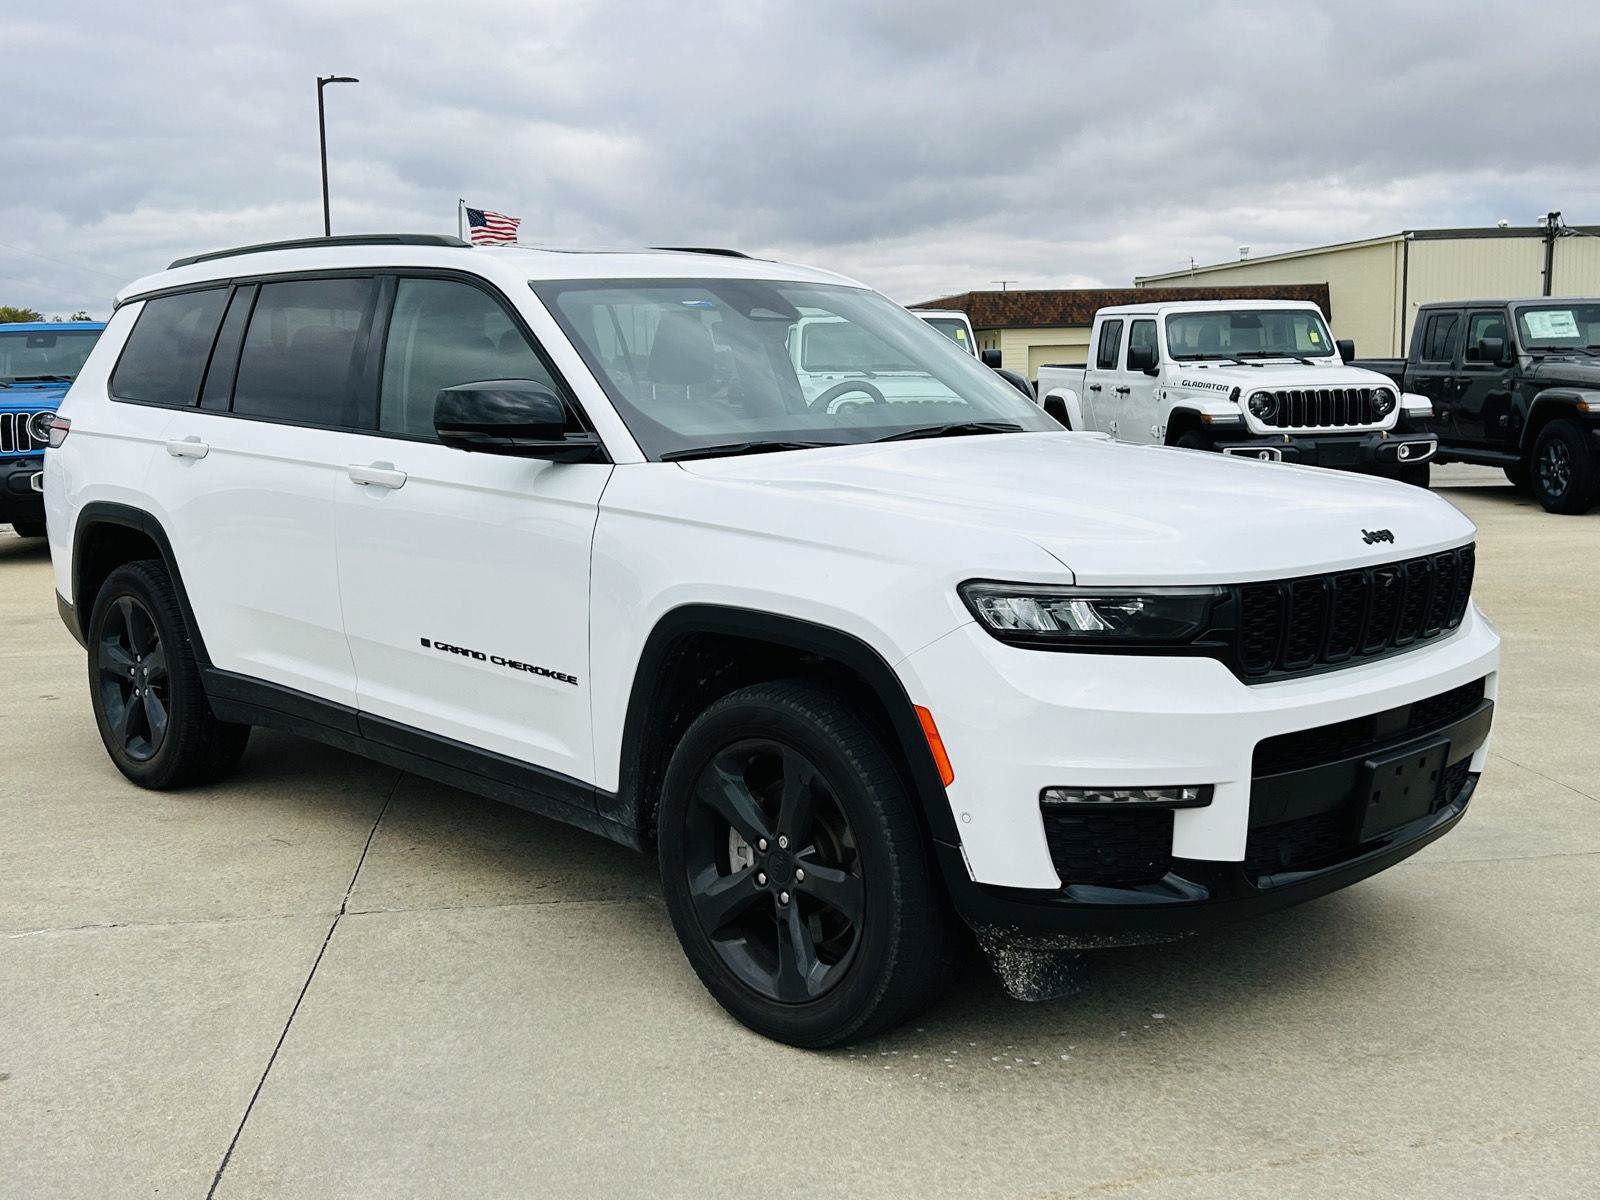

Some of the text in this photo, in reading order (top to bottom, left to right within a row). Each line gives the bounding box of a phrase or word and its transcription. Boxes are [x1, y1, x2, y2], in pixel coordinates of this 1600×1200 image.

[1182, 379, 1229, 392] GLADIATOR
[1361, 528, 1394, 545] Jeep
[434, 641, 578, 685] GRAND CHEROKEE
